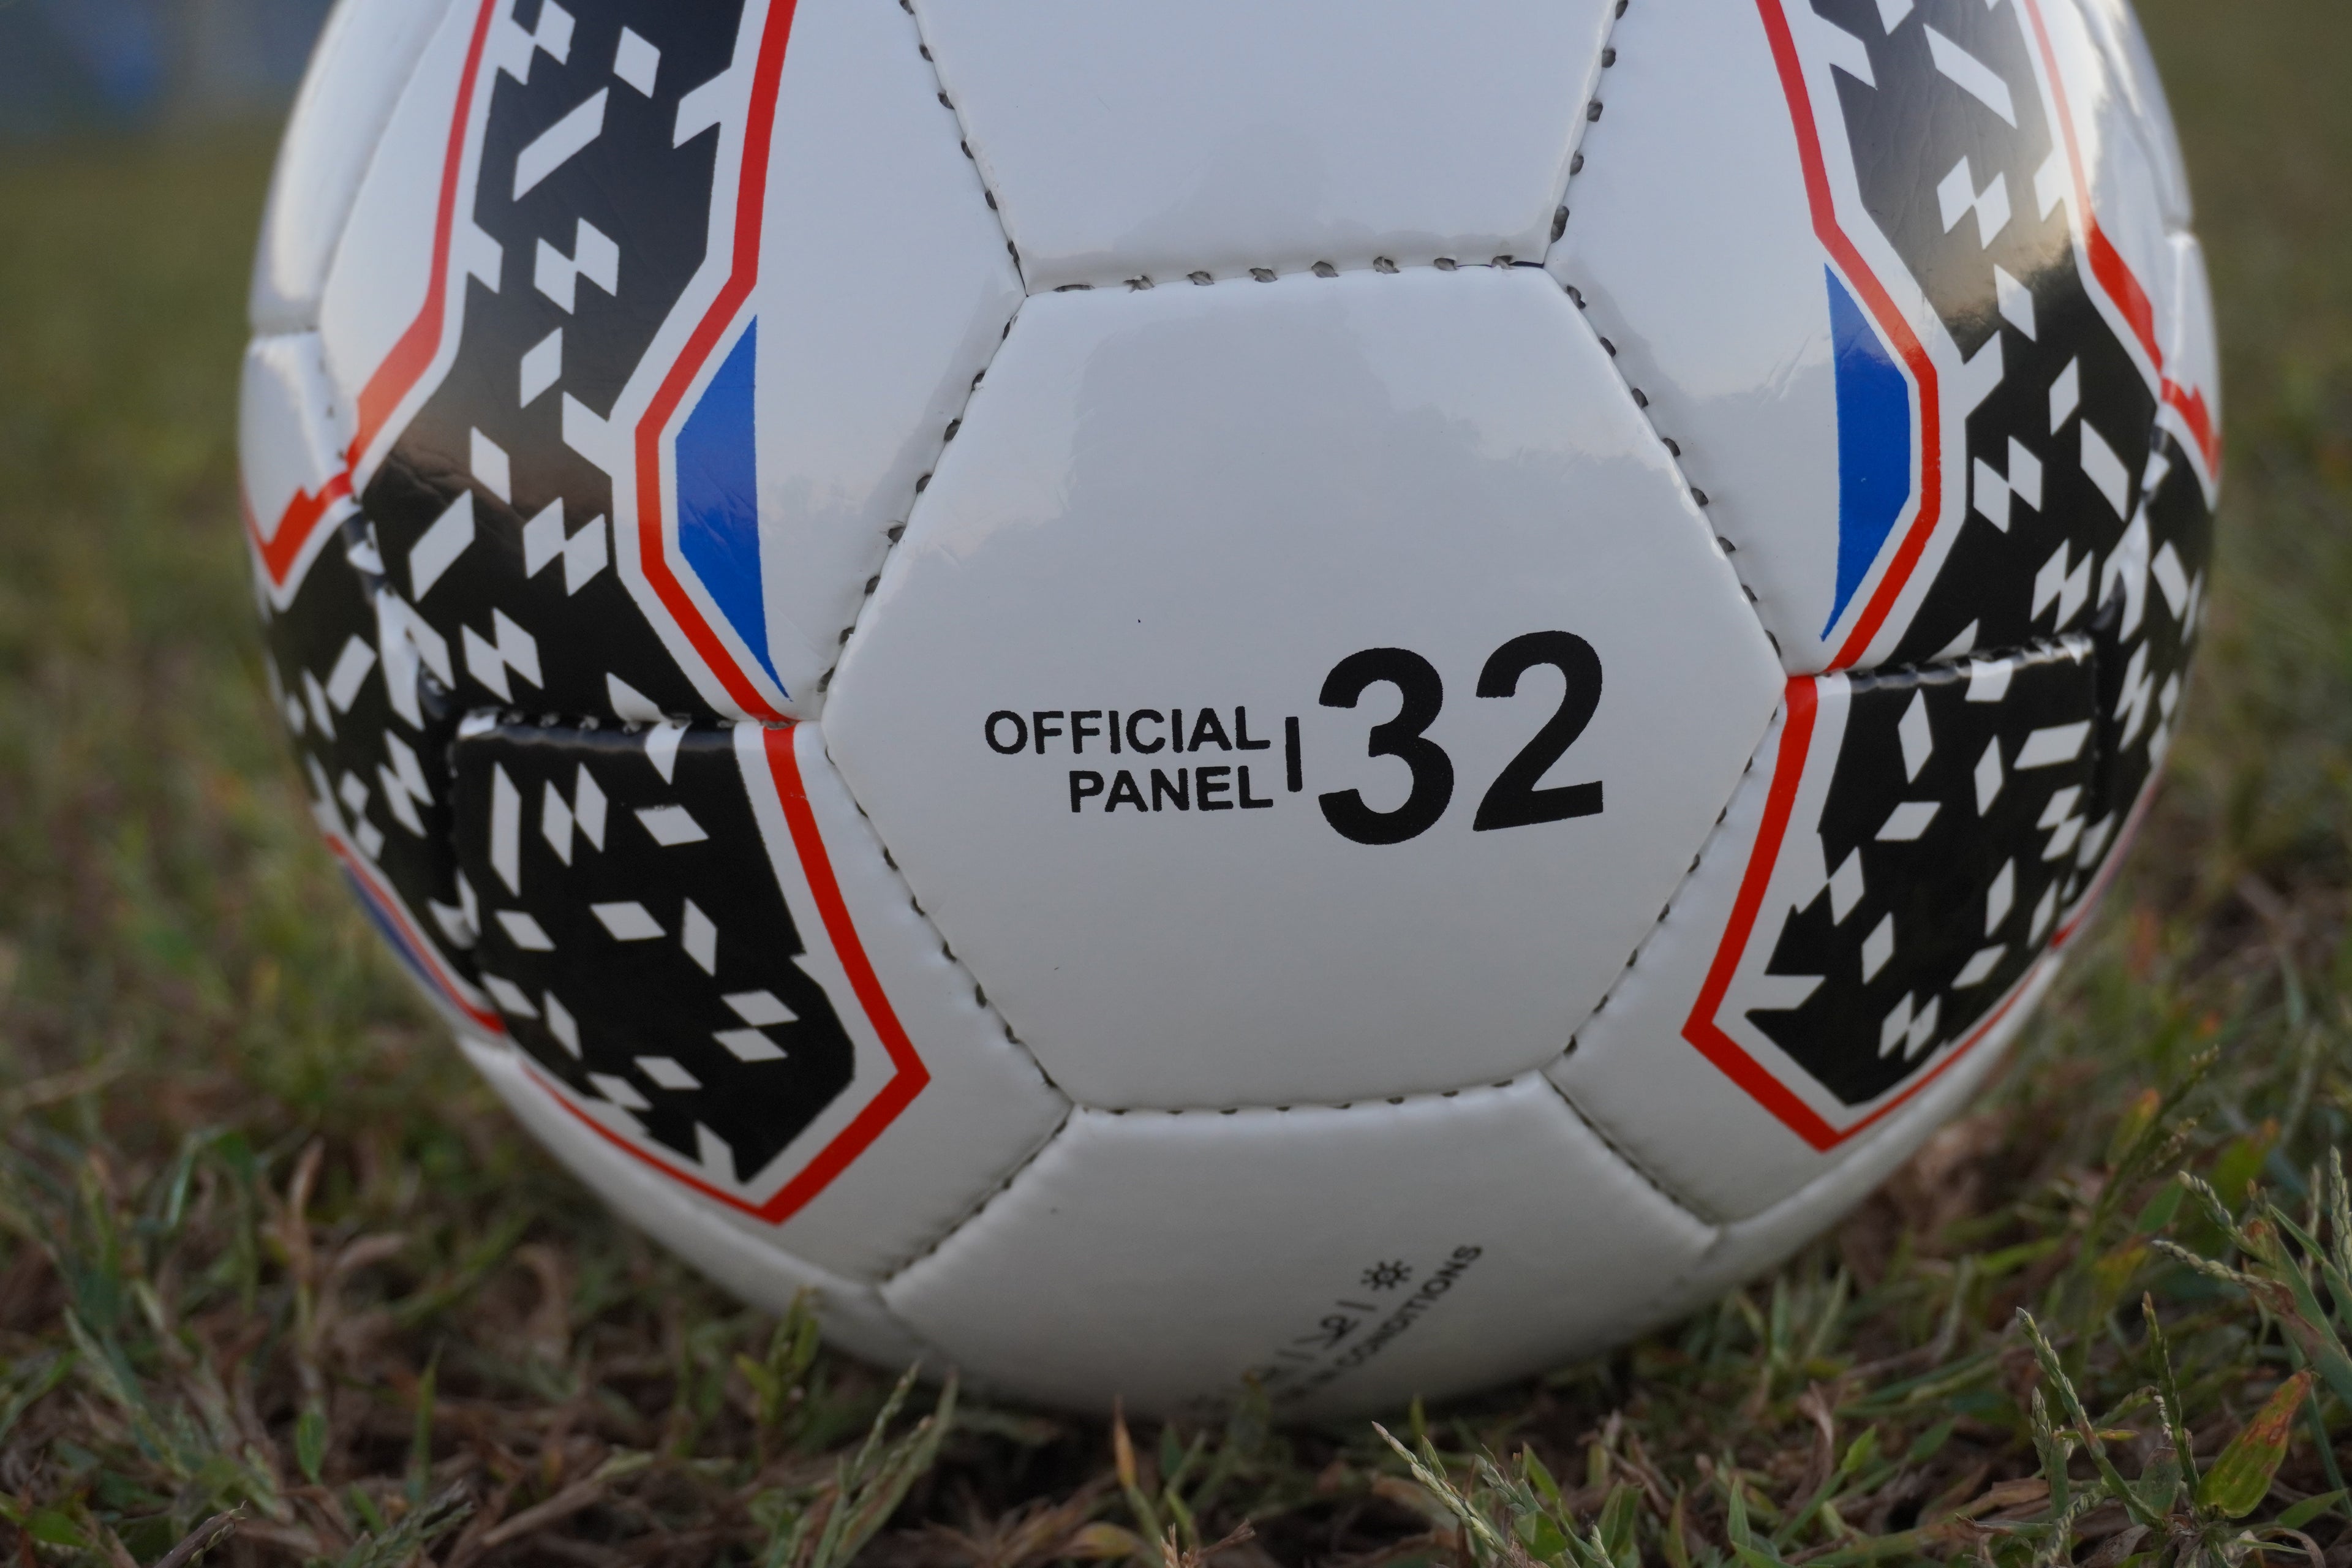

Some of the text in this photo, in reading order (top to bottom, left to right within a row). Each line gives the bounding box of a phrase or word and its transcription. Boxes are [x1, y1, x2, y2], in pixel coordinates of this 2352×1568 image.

[984, 705, 1271, 755] OFFICIAL
[1317, 629, 1604, 846] 32
[1069, 764, 1275, 813] PANEL
